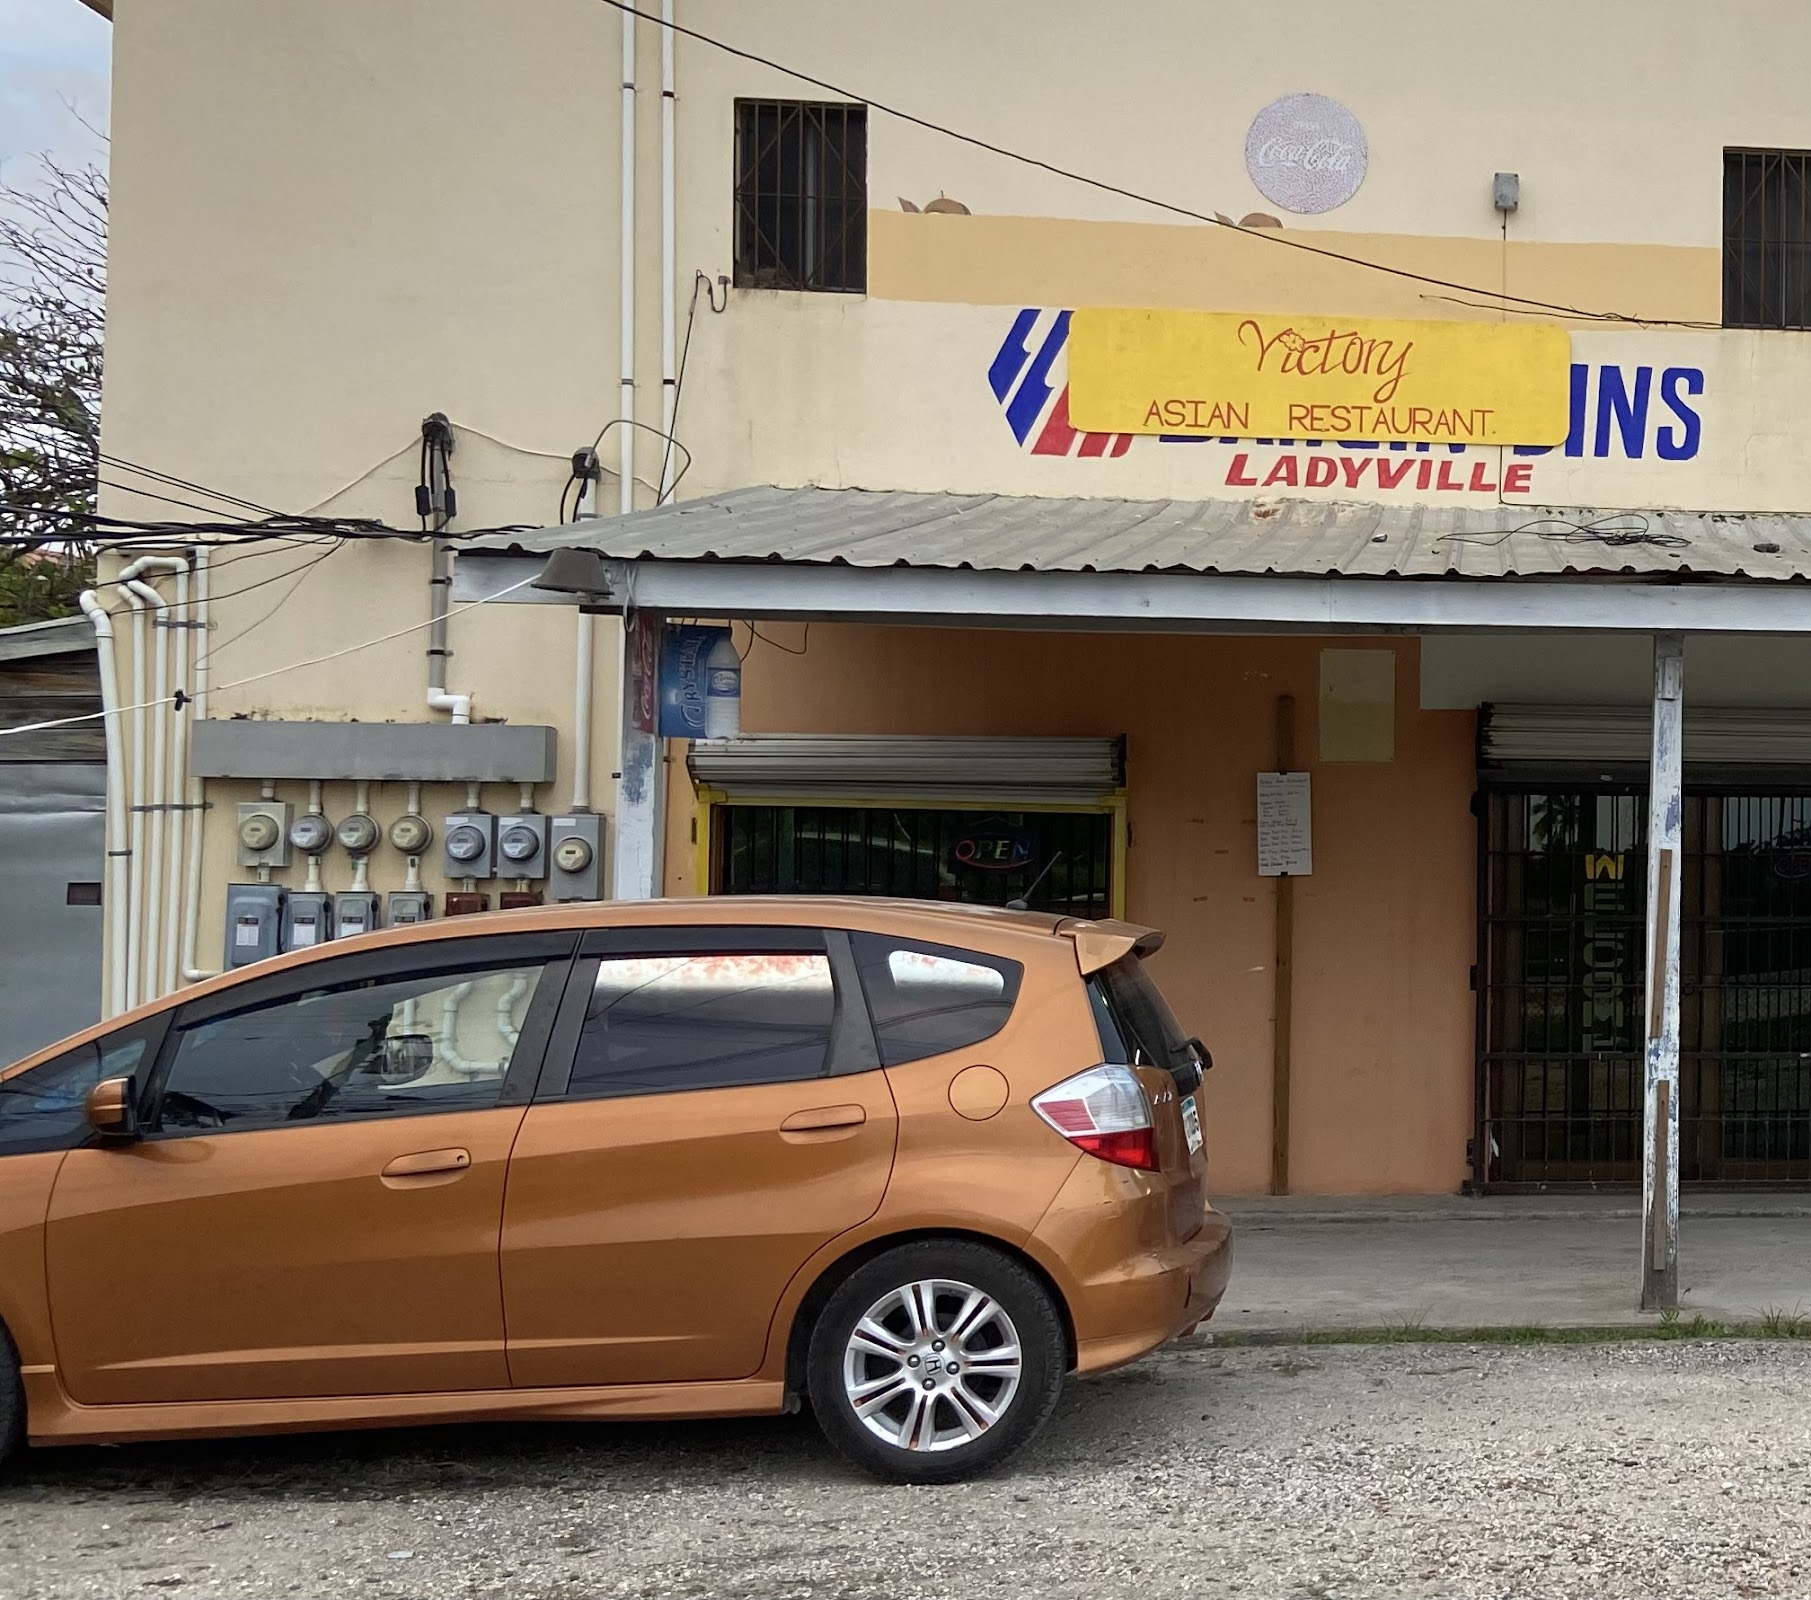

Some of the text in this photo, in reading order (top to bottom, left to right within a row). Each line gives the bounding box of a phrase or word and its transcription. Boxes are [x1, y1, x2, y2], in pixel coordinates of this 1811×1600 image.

[1237, 319, 1414, 404] Victory
[1143, 399, 1249, 430] ASIAN
[1512, 363, 1705, 461] INS
[1224, 453, 1533, 493] LADYVILLE
[955, 838, 1031, 861] OPEN
